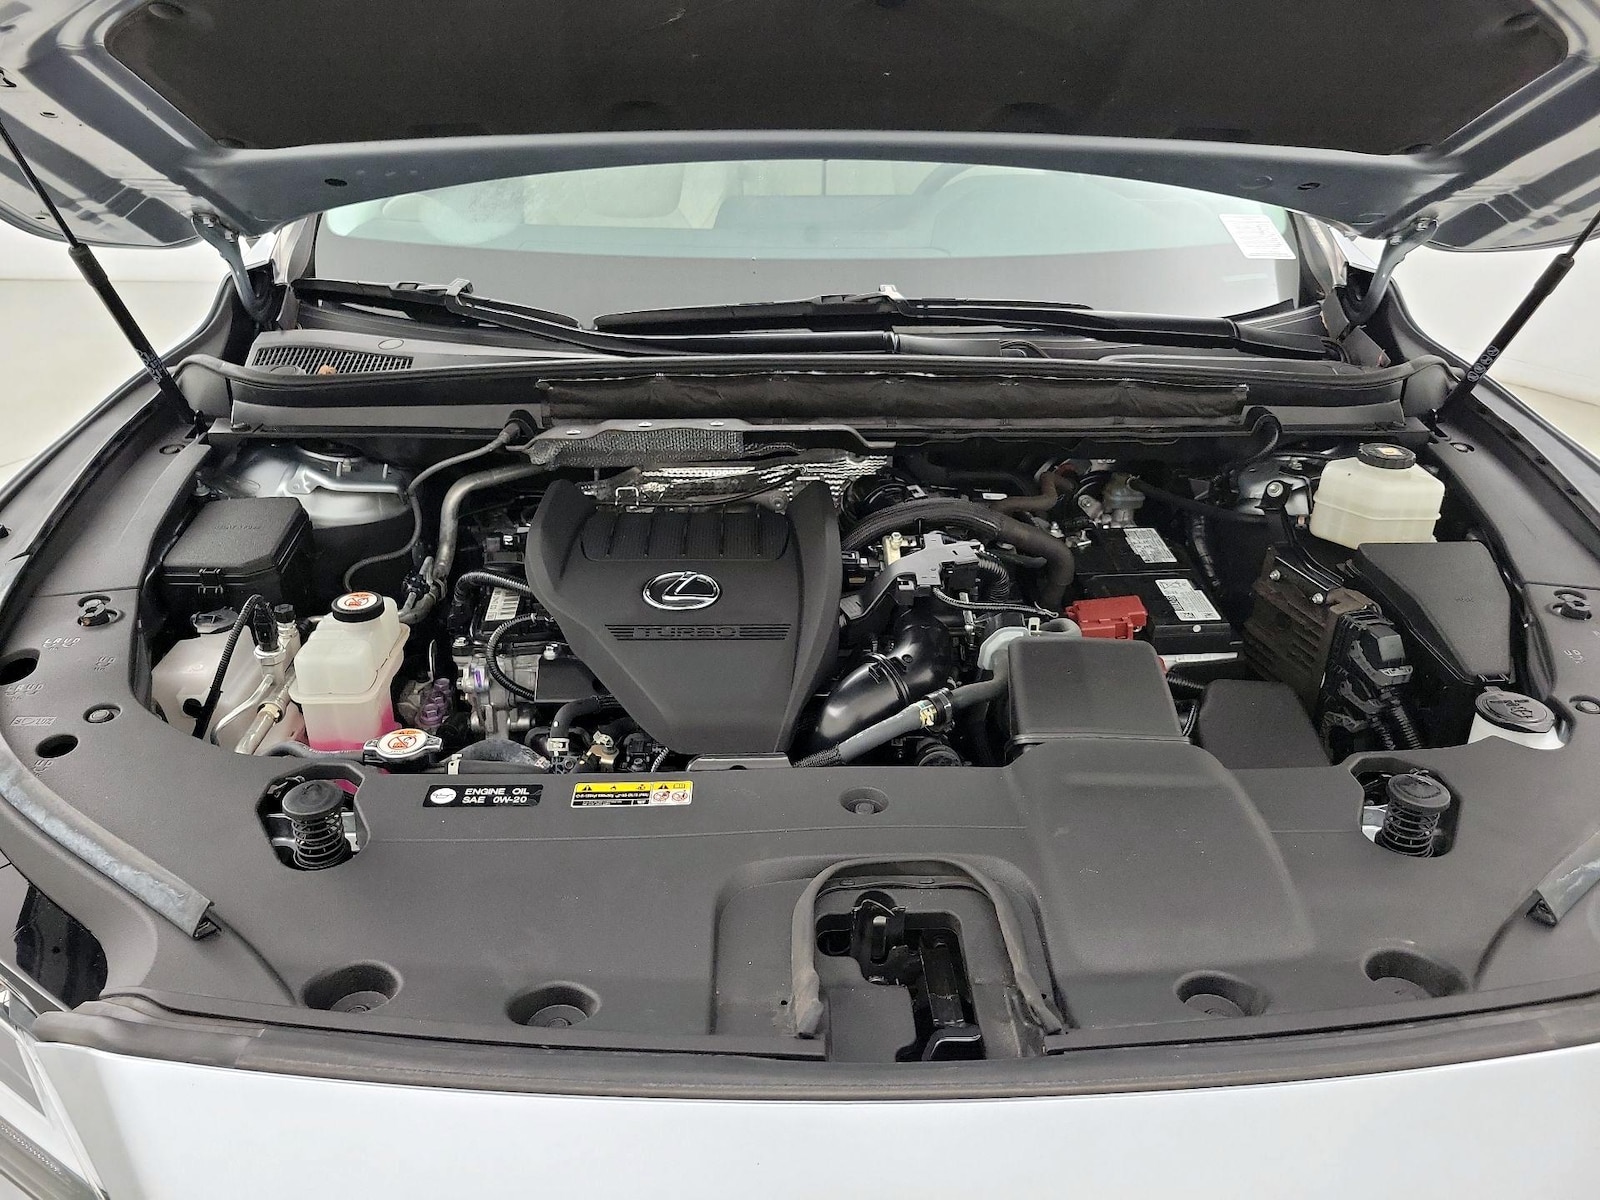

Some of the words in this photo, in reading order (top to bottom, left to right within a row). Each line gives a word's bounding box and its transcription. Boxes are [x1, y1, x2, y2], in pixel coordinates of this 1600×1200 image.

[634, 625, 738, 639] TURBO
[464, 787, 506, 795] ENGINE
[511, 787, 530, 795] OIL
[461, 796, 486, 804] SAE
[492, 796, 528, 804] 0W-20
